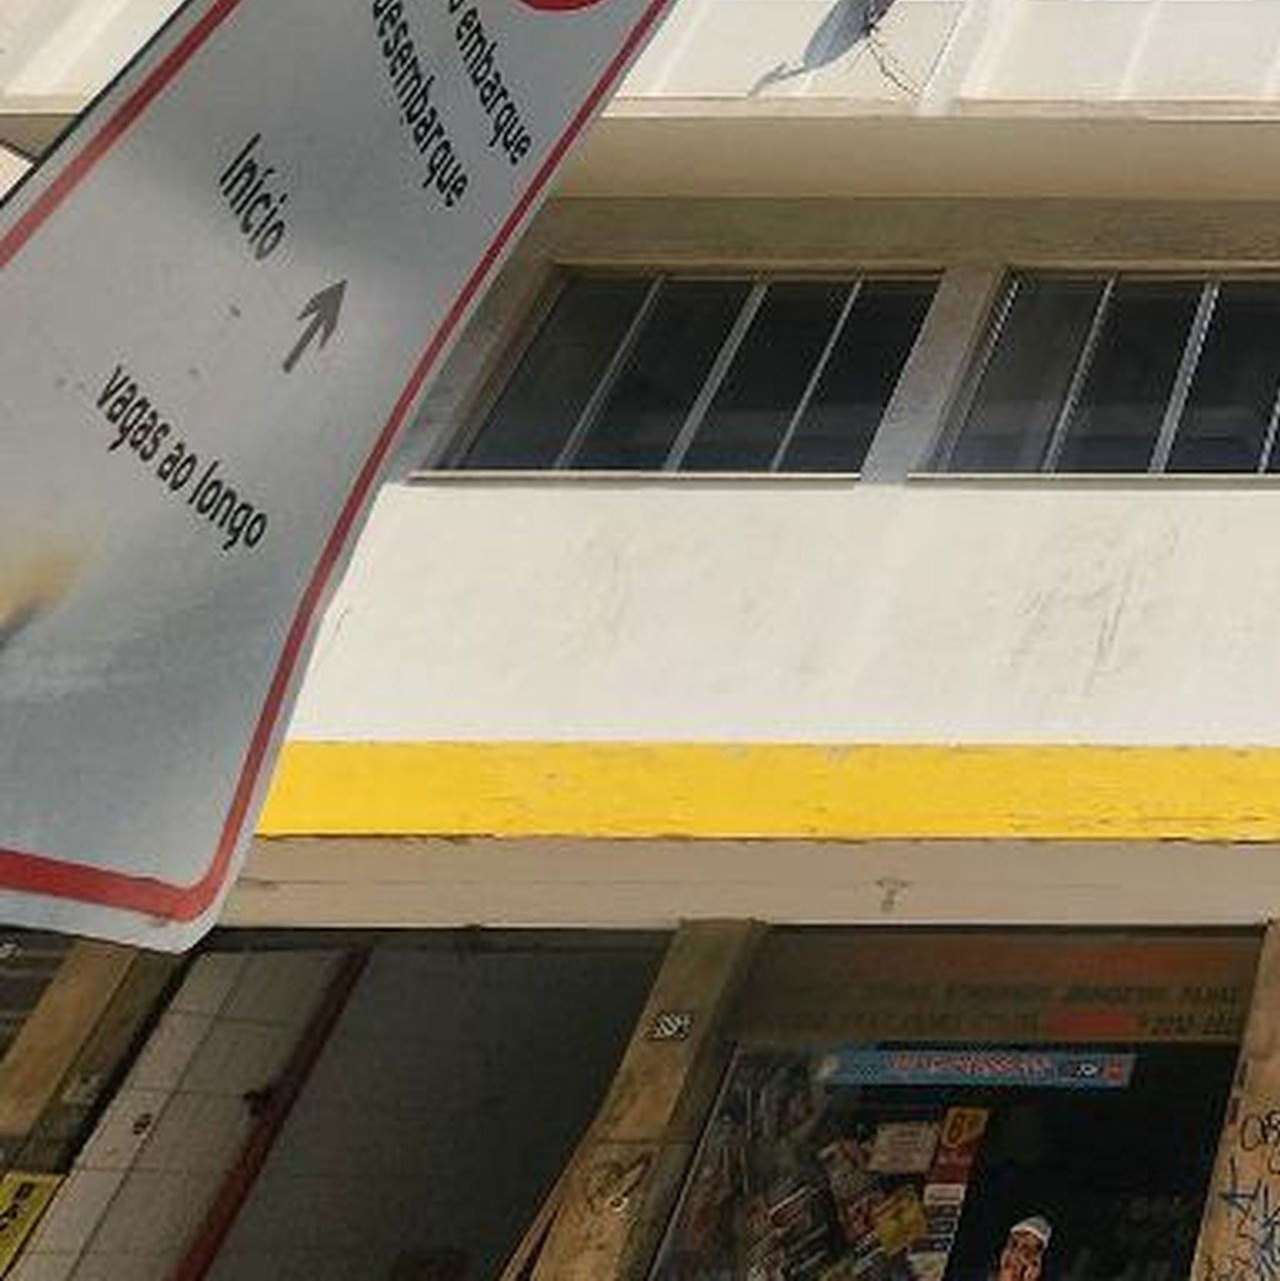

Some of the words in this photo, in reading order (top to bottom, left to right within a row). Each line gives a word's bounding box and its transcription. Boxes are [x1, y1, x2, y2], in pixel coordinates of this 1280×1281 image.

[456, 7, 532, 165] embarque
[219, 132, 288, 260] Início
[96, 364, 171, 462] vagas
[156, 441, 198, 492] ao
[186, 459, 268, 551] longo
